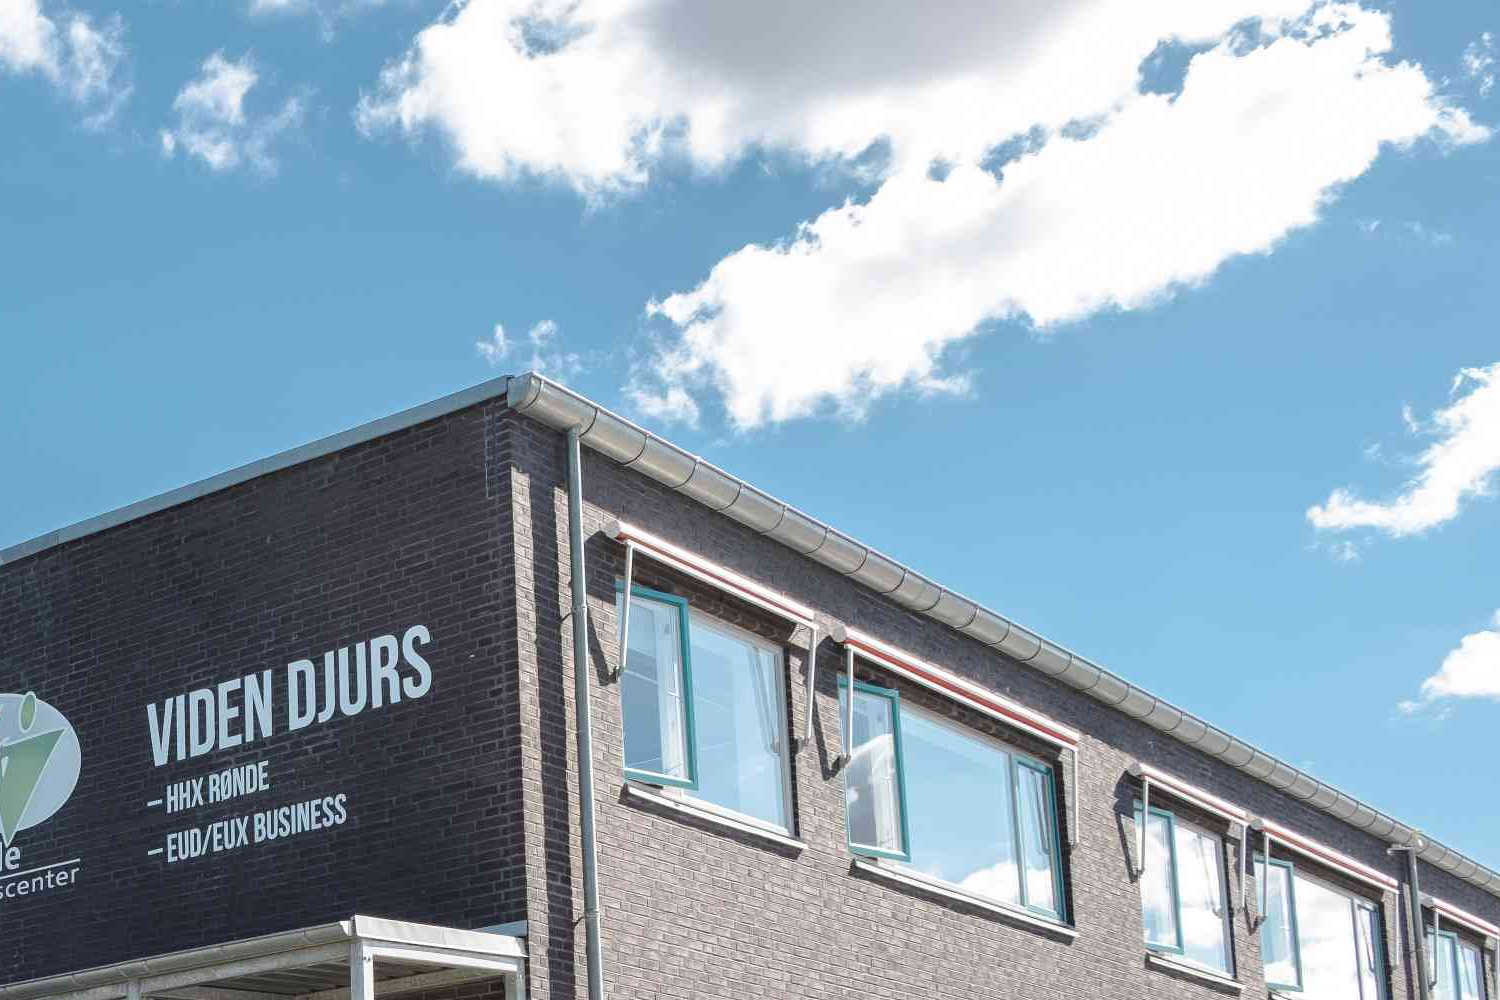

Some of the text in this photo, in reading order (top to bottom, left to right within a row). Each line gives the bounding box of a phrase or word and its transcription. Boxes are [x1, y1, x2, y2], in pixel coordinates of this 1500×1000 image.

[147, 624, 433, 767] VIDEN DJURS
[166, 776, 204, 814] HHX
[208, 760, 270, 803] RØNDE
[167, 815, 249, 863] EUD/EUX
[253, 793, 347, 843] BUSINESS
